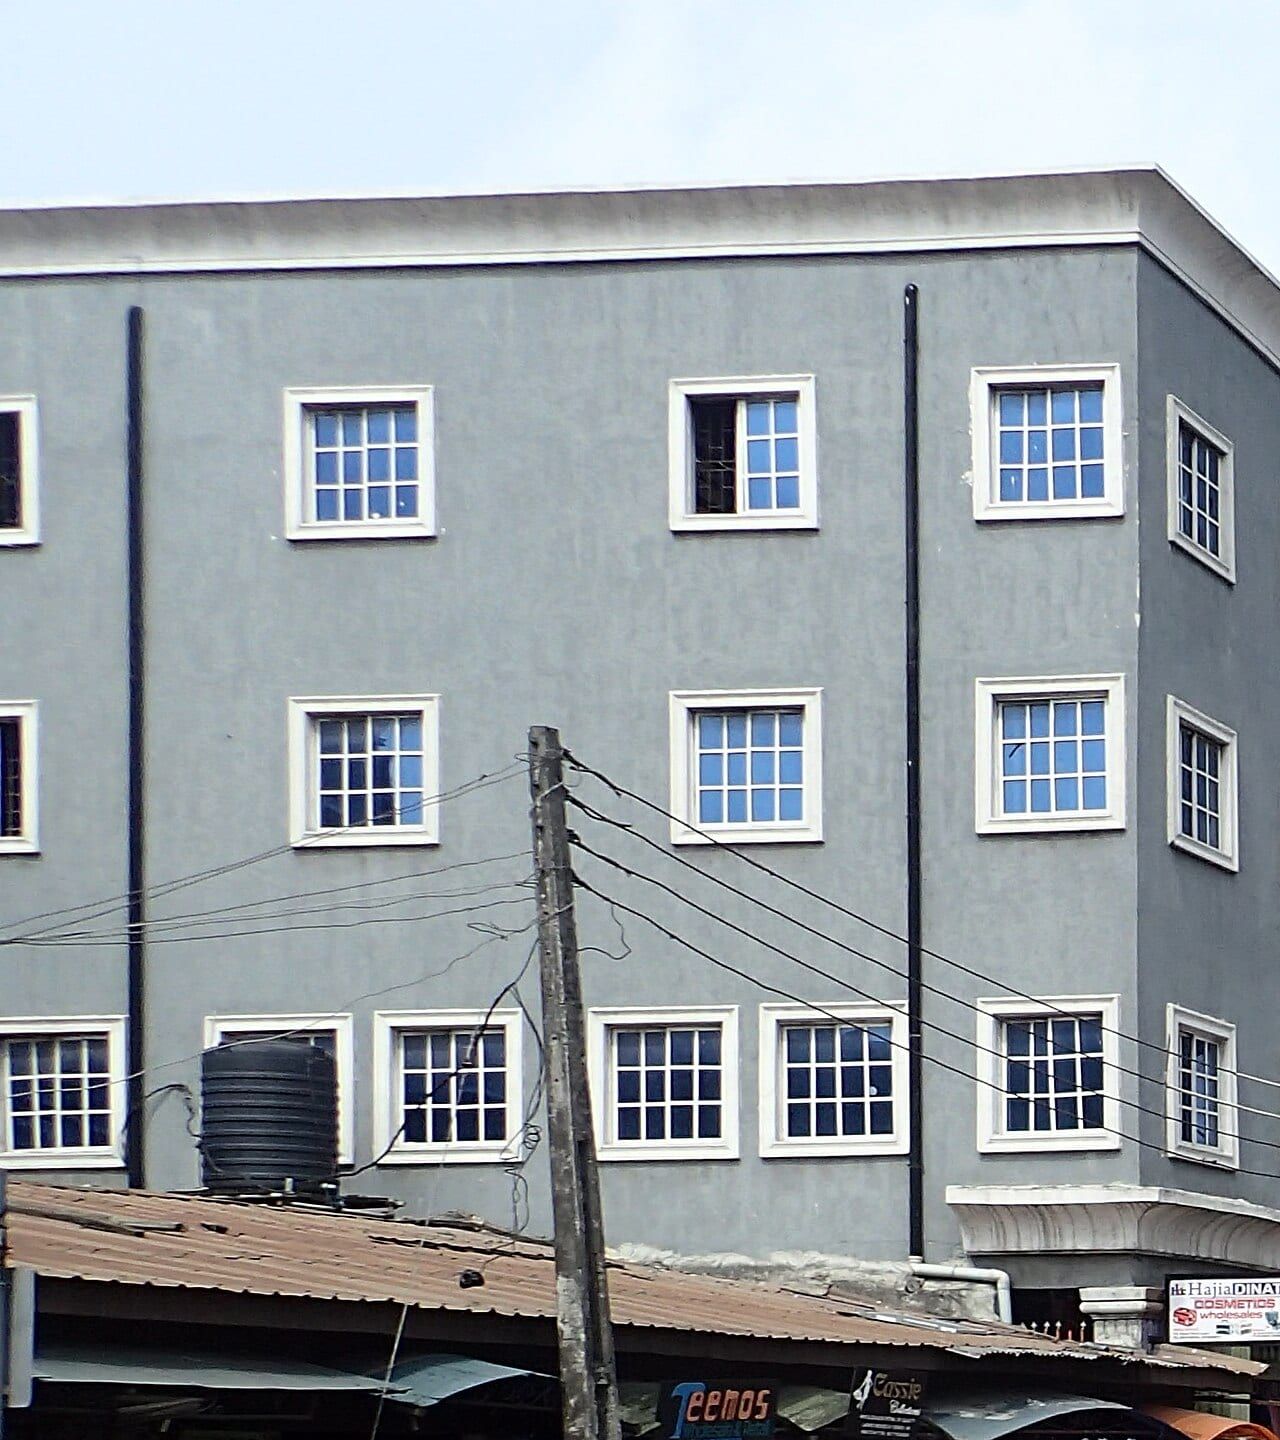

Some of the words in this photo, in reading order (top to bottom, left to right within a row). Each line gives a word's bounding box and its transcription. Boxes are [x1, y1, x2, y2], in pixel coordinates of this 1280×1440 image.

[1188, 1282, 1233, 1298] Hajia
[1194, 1299, 1276, 1309] COSMETICS
[1200, 1310, 1263, 1319] wholesales
[873, 1373, 921, 1400] Cassie
